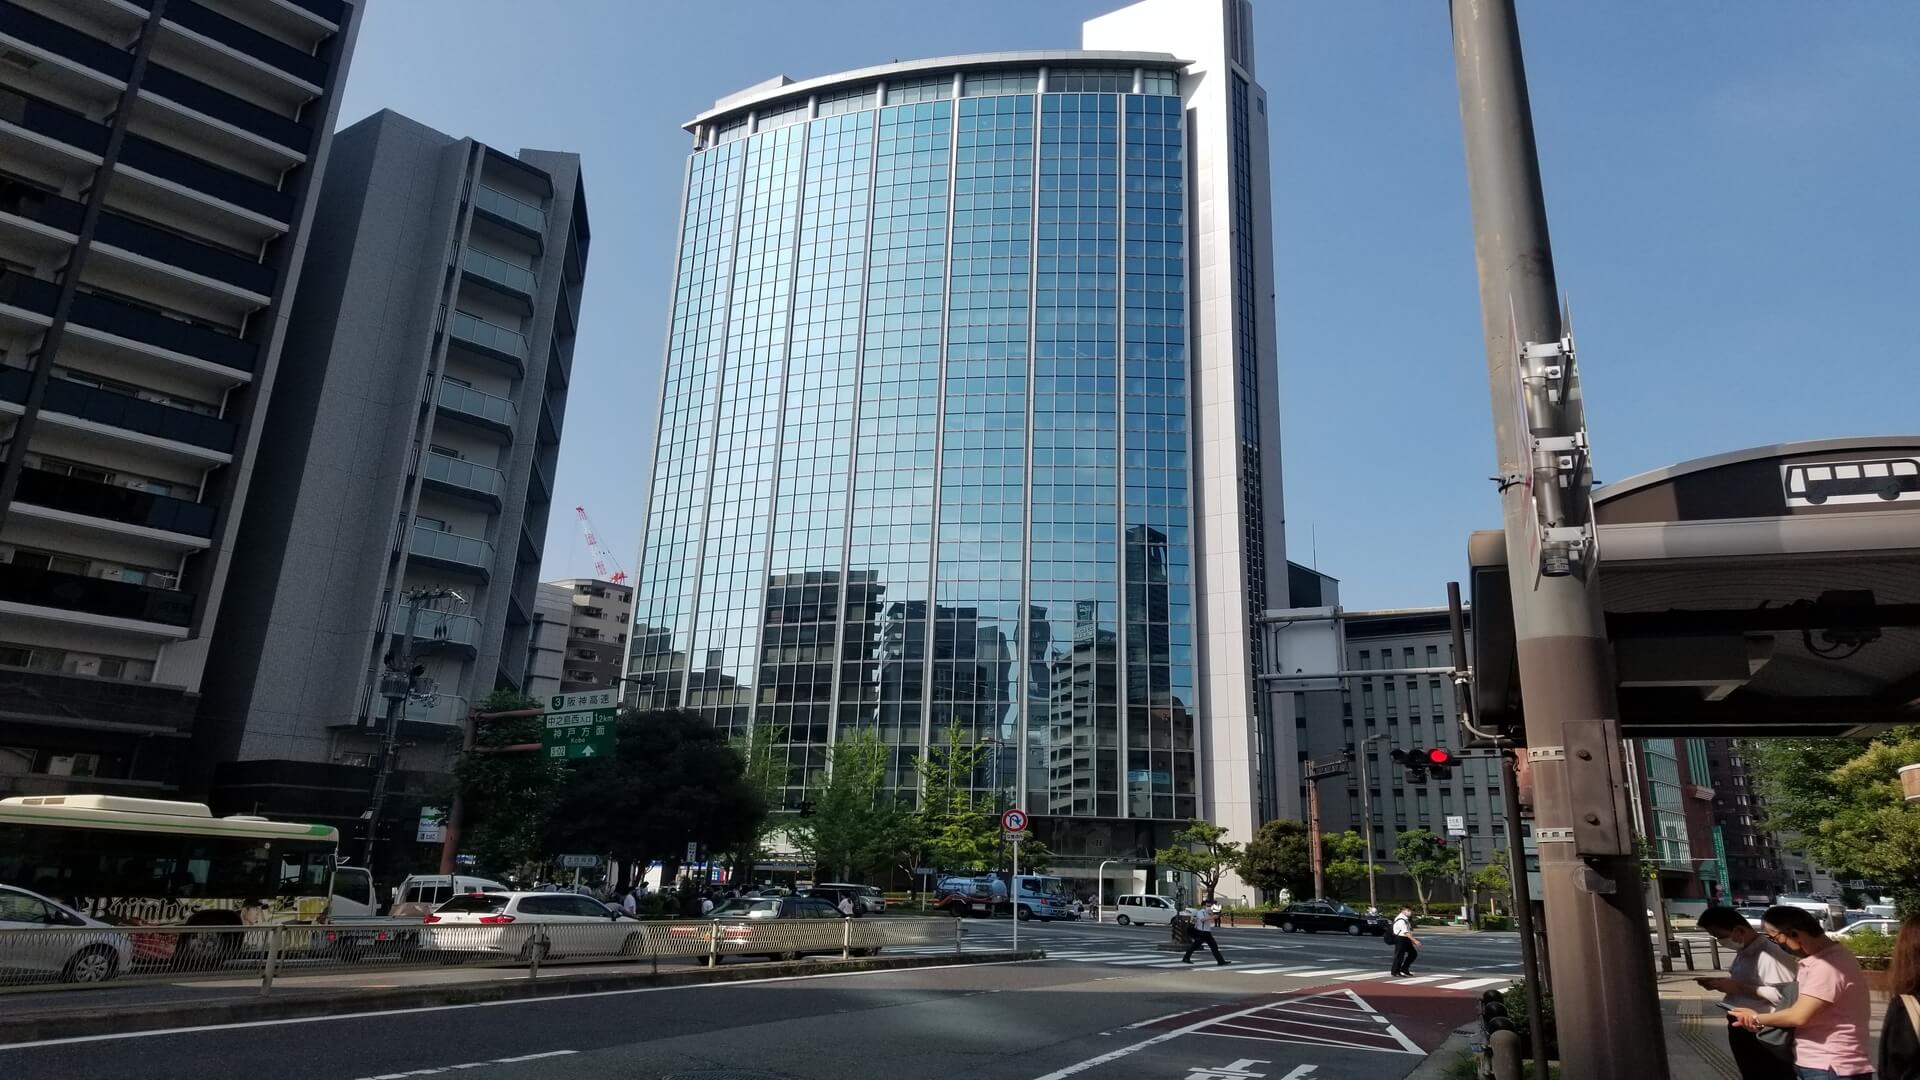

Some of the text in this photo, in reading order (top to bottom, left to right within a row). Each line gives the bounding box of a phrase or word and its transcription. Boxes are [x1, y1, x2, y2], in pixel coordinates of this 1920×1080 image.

[567, 694, 609, 707] 阪神高速
[553, 725, 605, 739] 神戸方面
